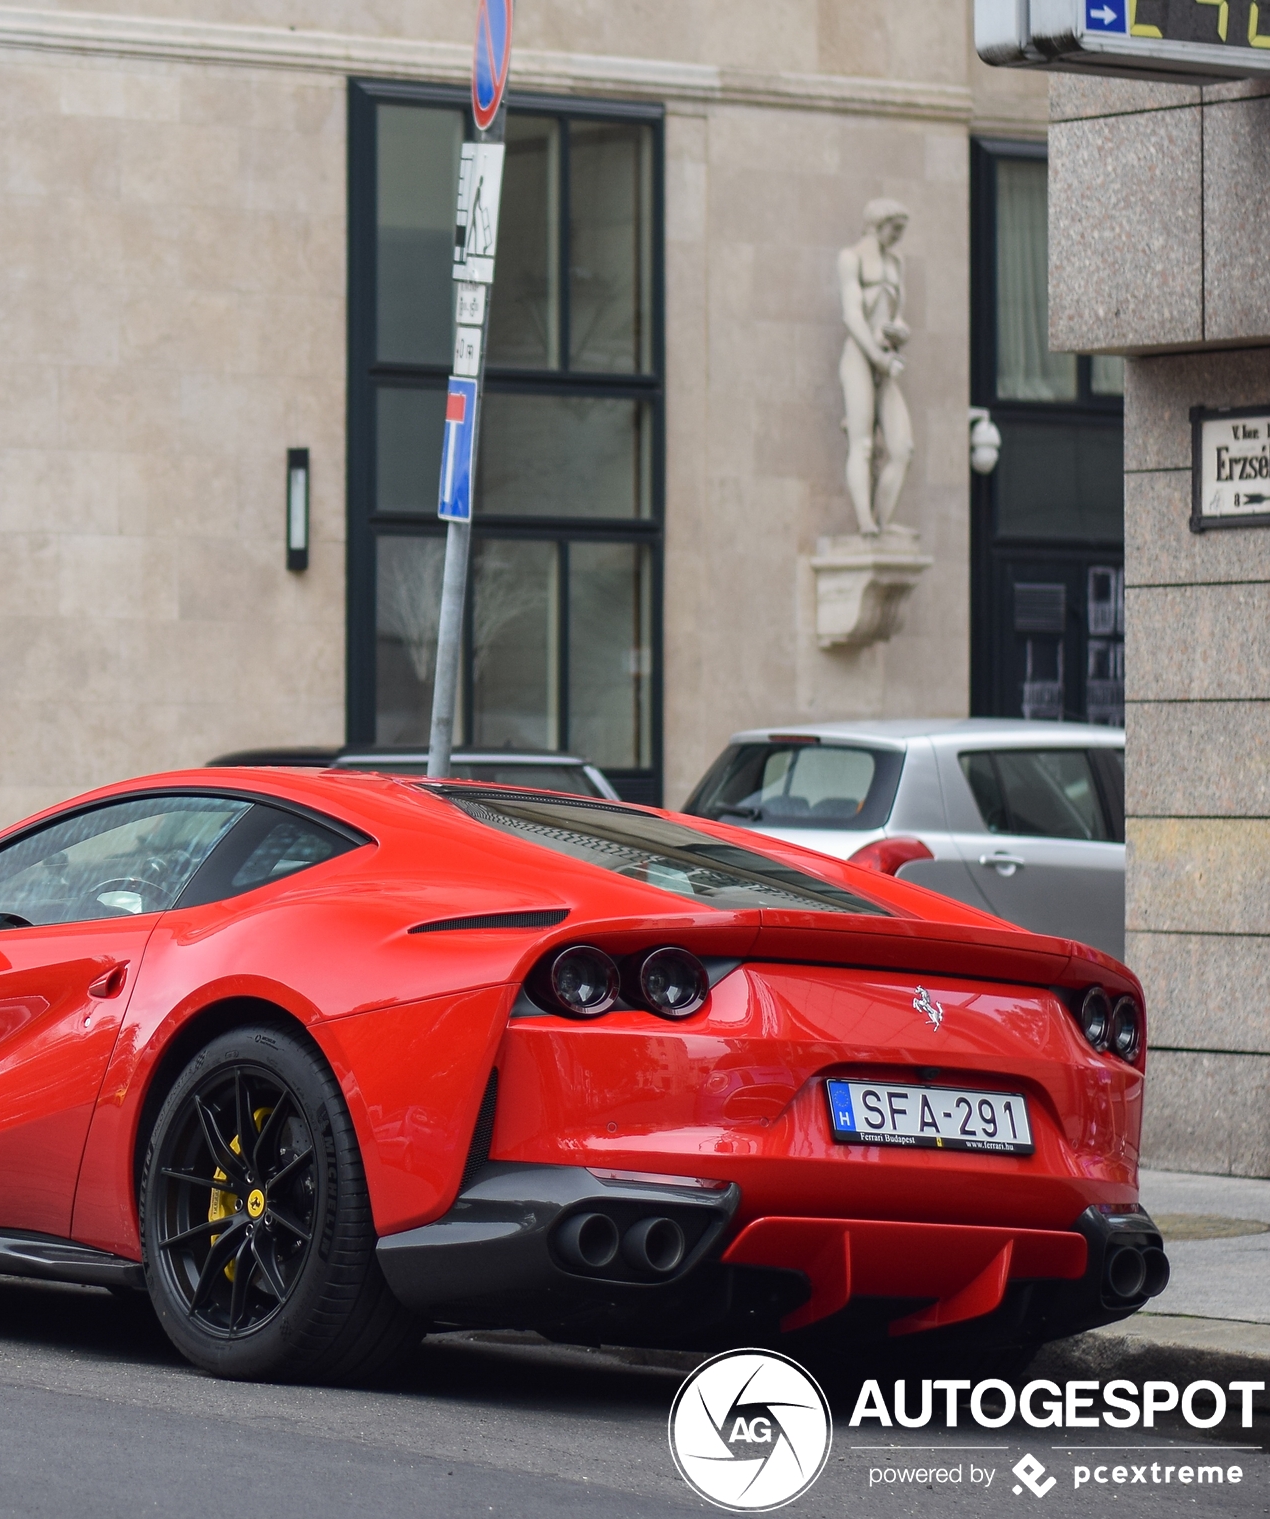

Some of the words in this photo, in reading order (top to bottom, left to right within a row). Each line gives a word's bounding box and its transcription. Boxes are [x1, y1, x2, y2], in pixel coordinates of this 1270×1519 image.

[1232, 425, 1240, 440] V.
[1242, 424, 1259, 440] ker.
[1216, 445, 1270, 482] Erzsé
[839, 1111, 851, 1126] H
[860, 1089, 1018, 1140] SFA-291
[860, 1132, 883, 1142] Ferrari
[885, 1134, 915, 1145] Budapest
[965, 1139, 1014, 1150] www.ferrari.hu
